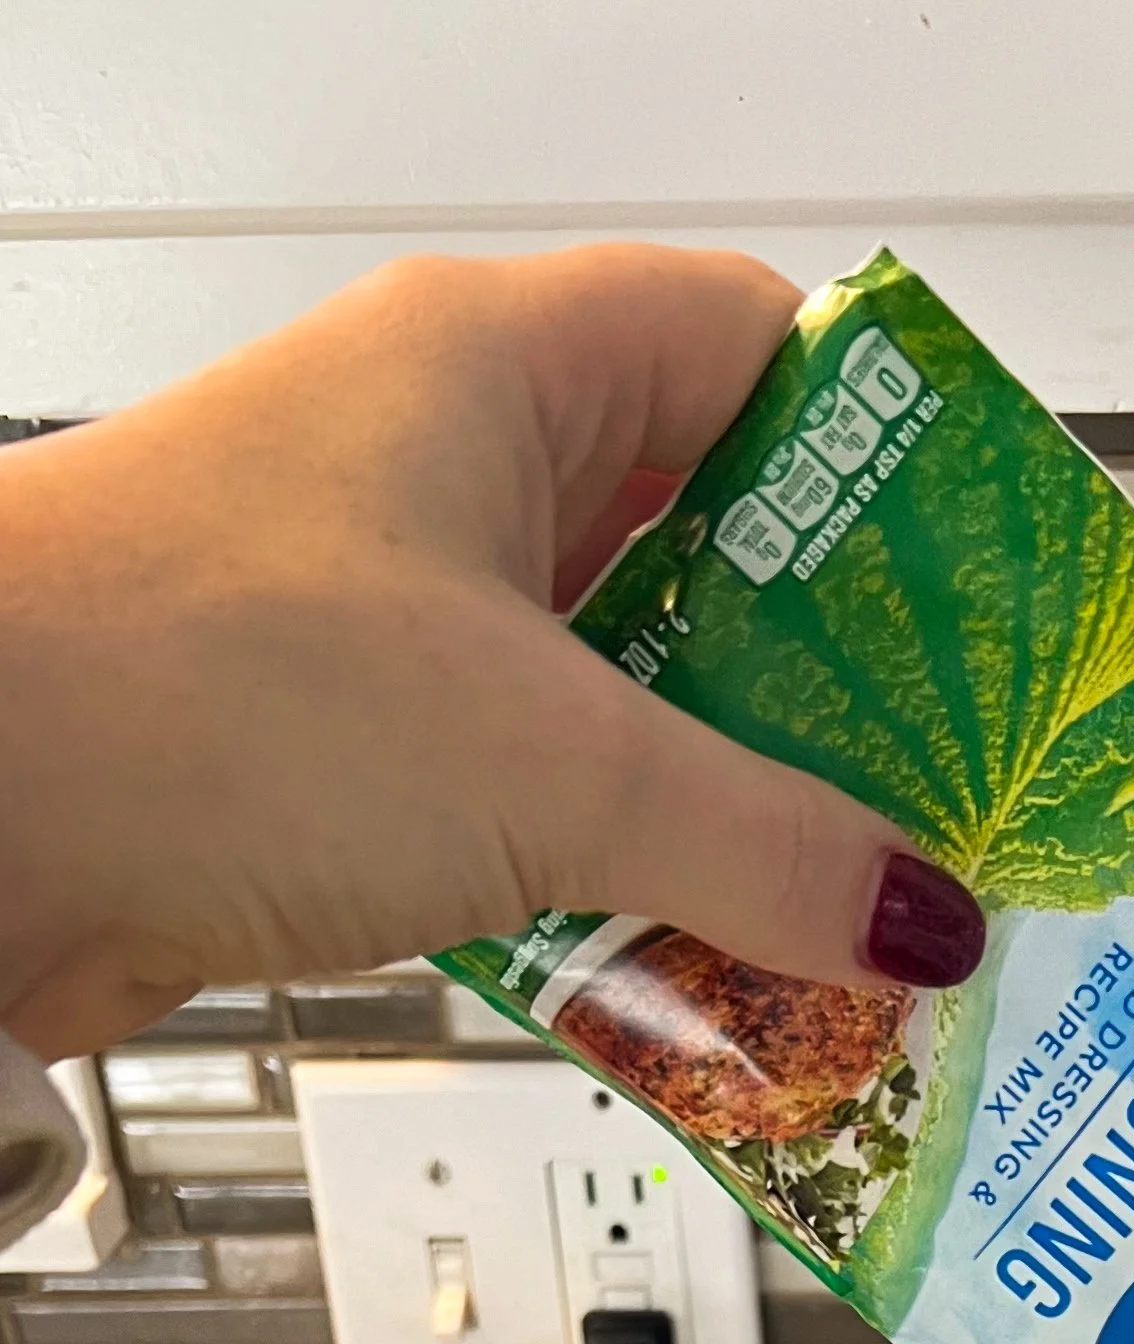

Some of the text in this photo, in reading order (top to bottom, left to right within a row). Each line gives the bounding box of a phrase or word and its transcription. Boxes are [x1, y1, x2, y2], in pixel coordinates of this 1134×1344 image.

[915, 389, 944, 423] PER
[874, 443, 904, 480] TSP
[853, 473, 878, 502] AS
[792, 496, 861, 581] PACKAGED
[983, 942, 1134, 1125] RECIPE MIX
[993, 1016, 1129, 1180] DRESSING
[968, 1180, 997, 1206] &
